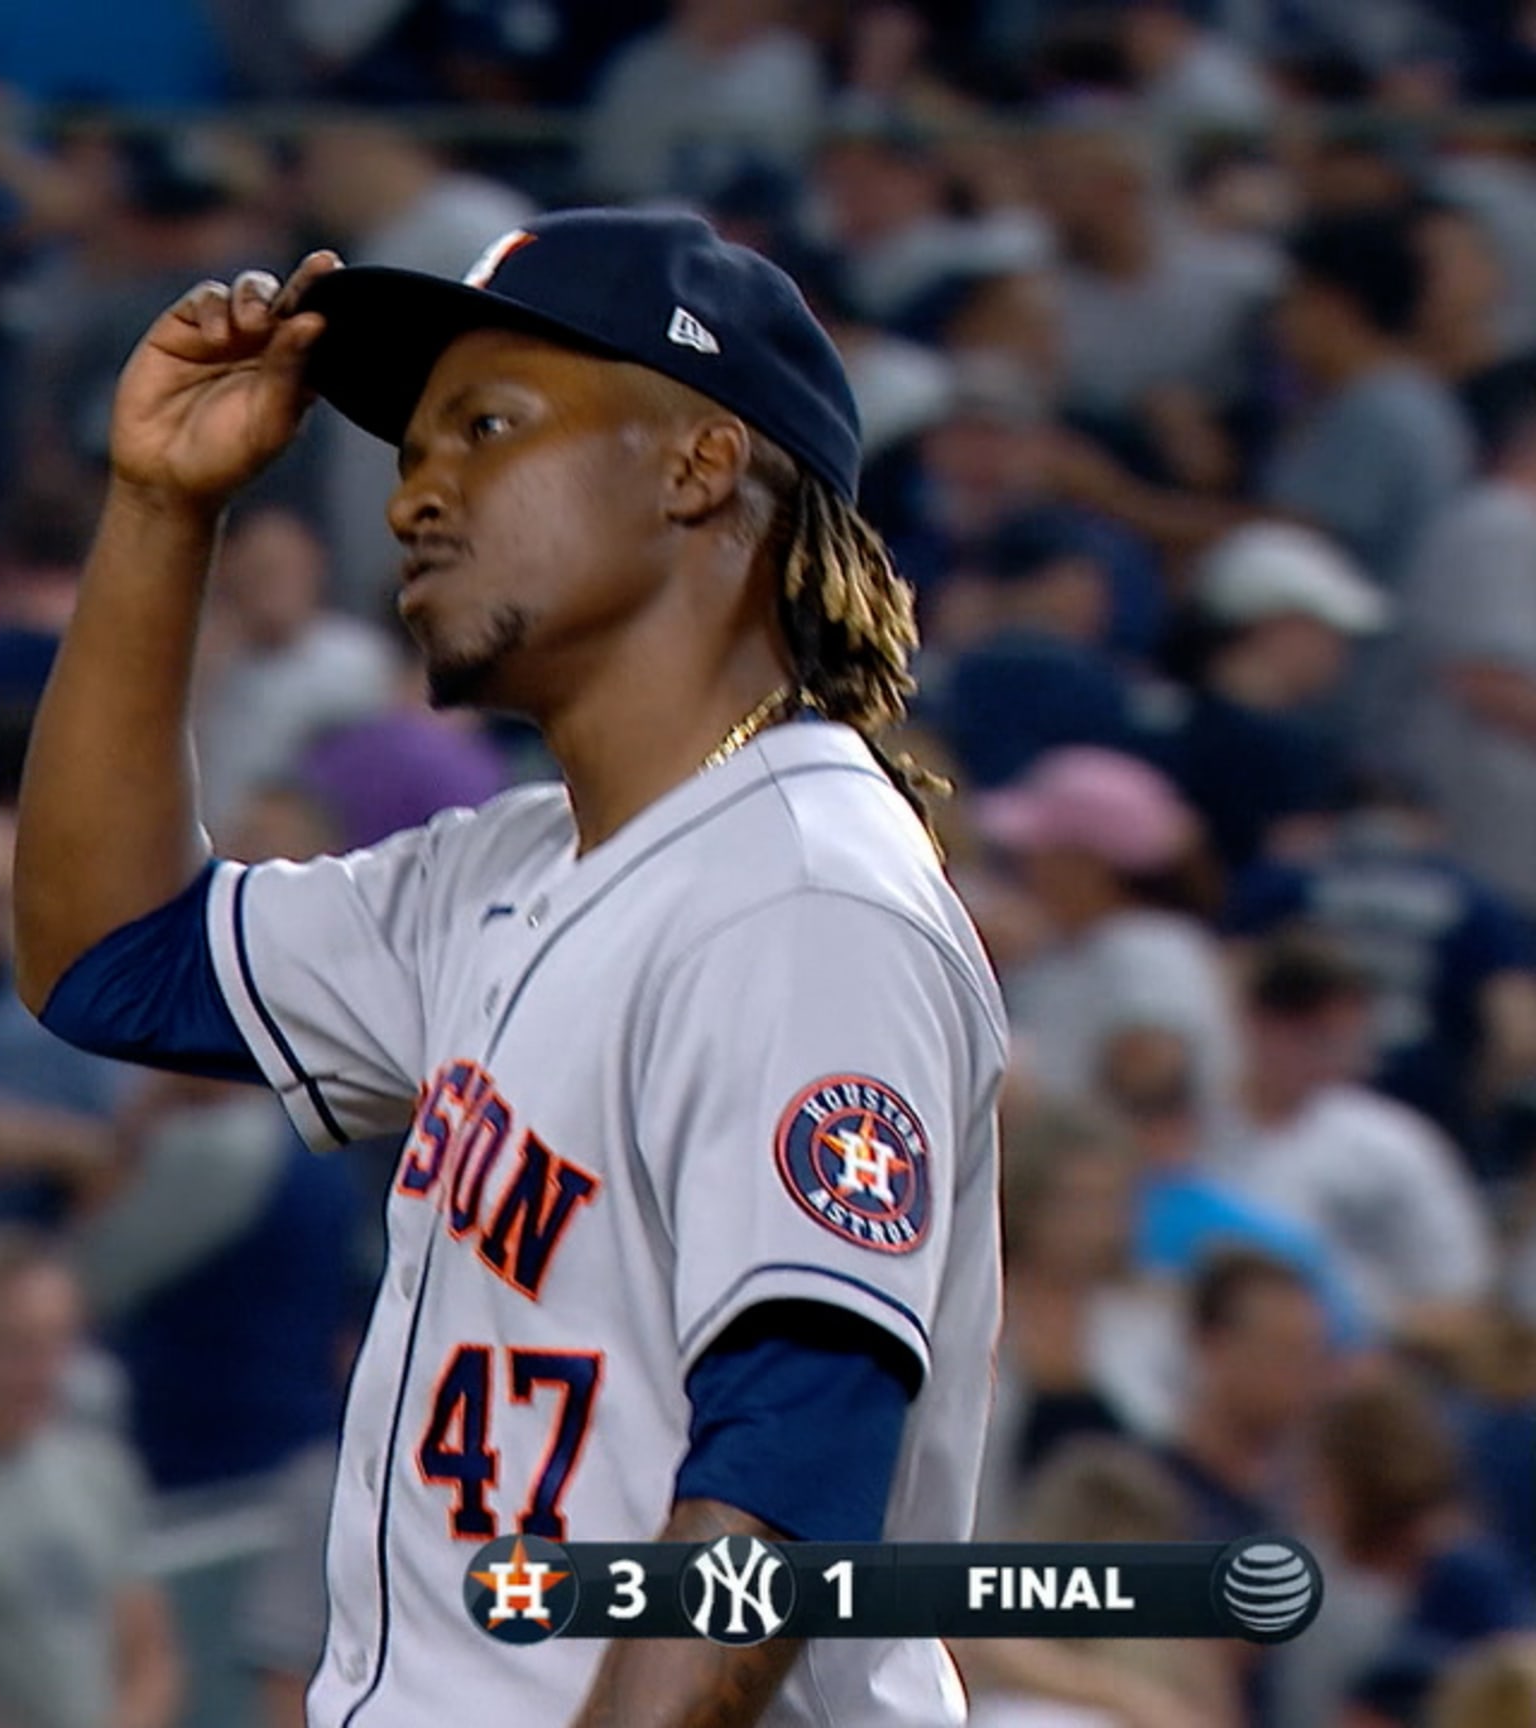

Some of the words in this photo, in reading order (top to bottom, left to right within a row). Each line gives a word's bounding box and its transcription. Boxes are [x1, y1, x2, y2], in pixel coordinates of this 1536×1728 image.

[802, 1082, 926, 1157] HOUSTON
[835, 1128, 897, 1206] H
[807, 1188, 918, 1245] ASTROS
[414, 1343, 604, 1541] 47
